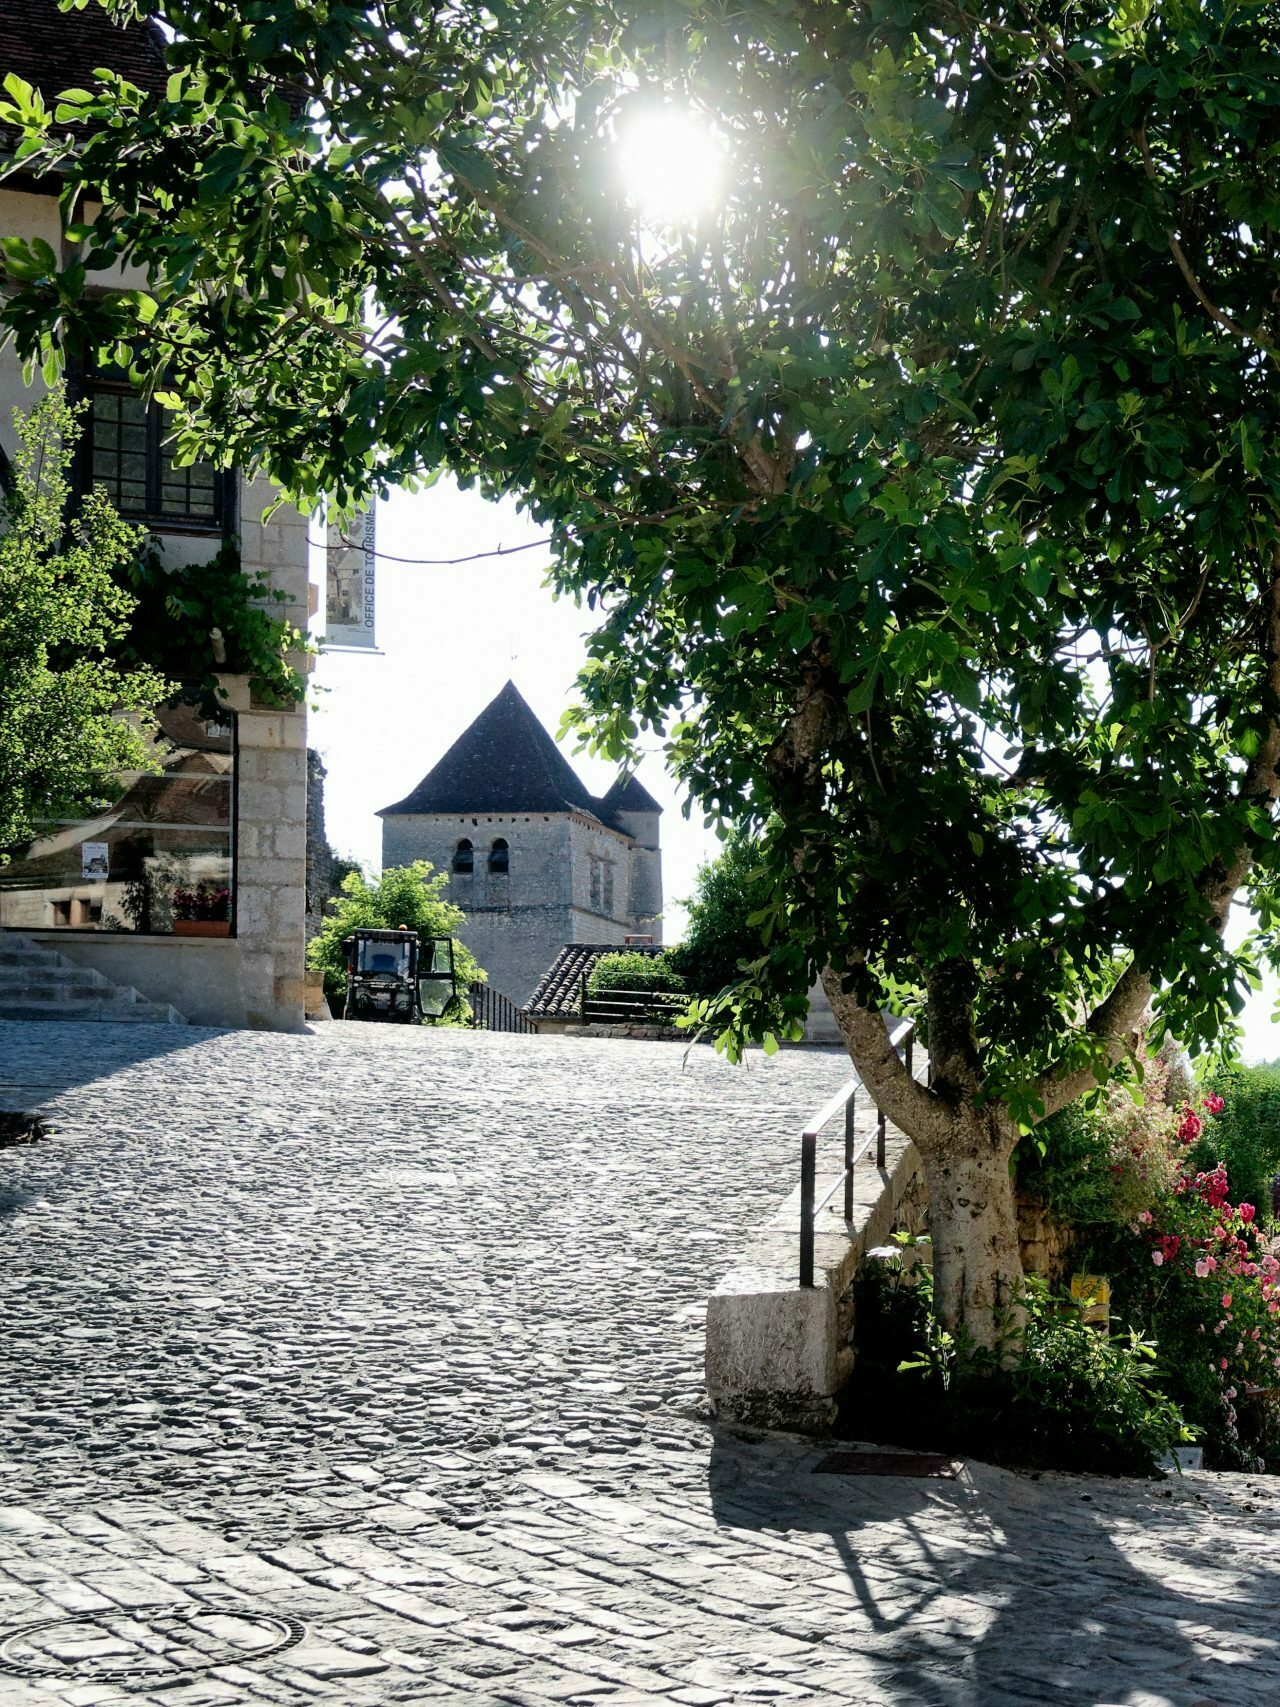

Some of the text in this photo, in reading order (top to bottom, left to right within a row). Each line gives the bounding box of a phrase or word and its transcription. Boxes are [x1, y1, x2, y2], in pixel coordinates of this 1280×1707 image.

[365, 510, 375, 627] OFFICE DE TOURISME
